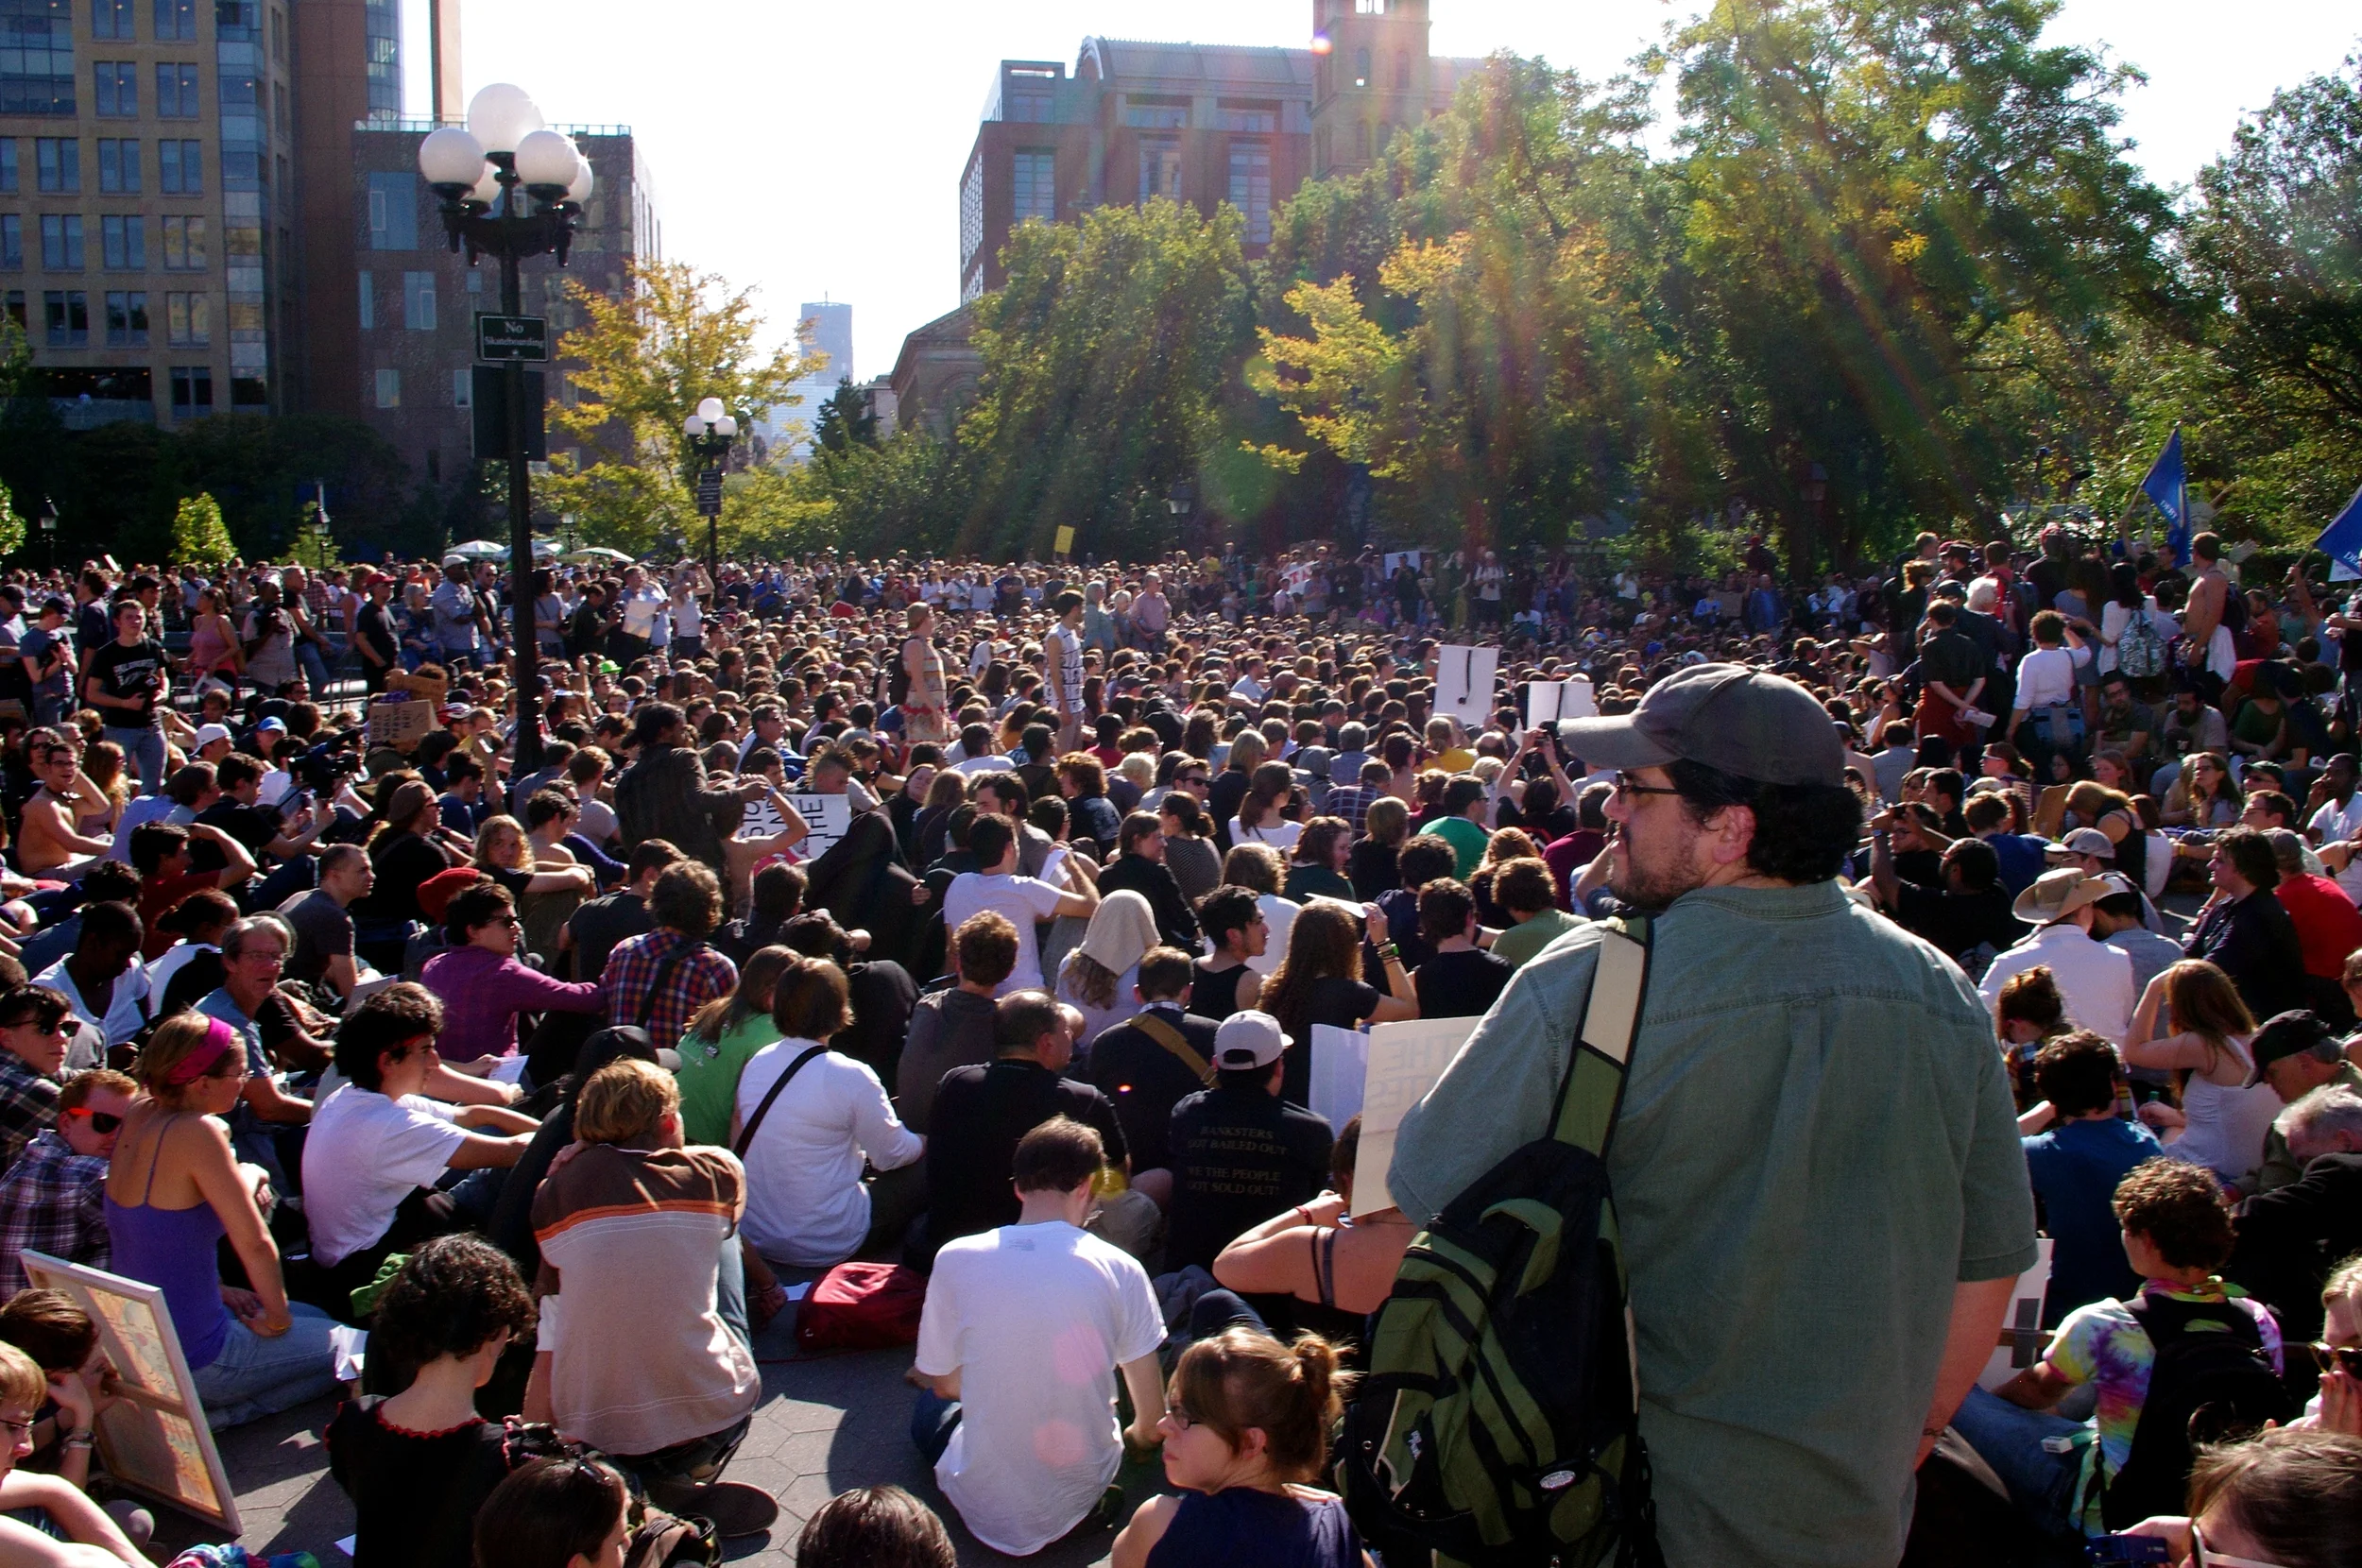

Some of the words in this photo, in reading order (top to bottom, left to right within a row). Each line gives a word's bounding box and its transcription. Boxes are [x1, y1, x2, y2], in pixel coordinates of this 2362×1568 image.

[504, 321, 524, 333] No
[798, 799, 829, 845] THE
[1200, 1126, 1275, 1139] BANKSTERS
[1210, 1139, 1258, 1150] BAILED
[1258, 1143, 1288, 1155] OUT
[1205, 1167, 1229, 1179] THE
[1232, 1169, 1282, 1181] PEOPLE
[1211, 1182, 1245, 1194] SOLD
